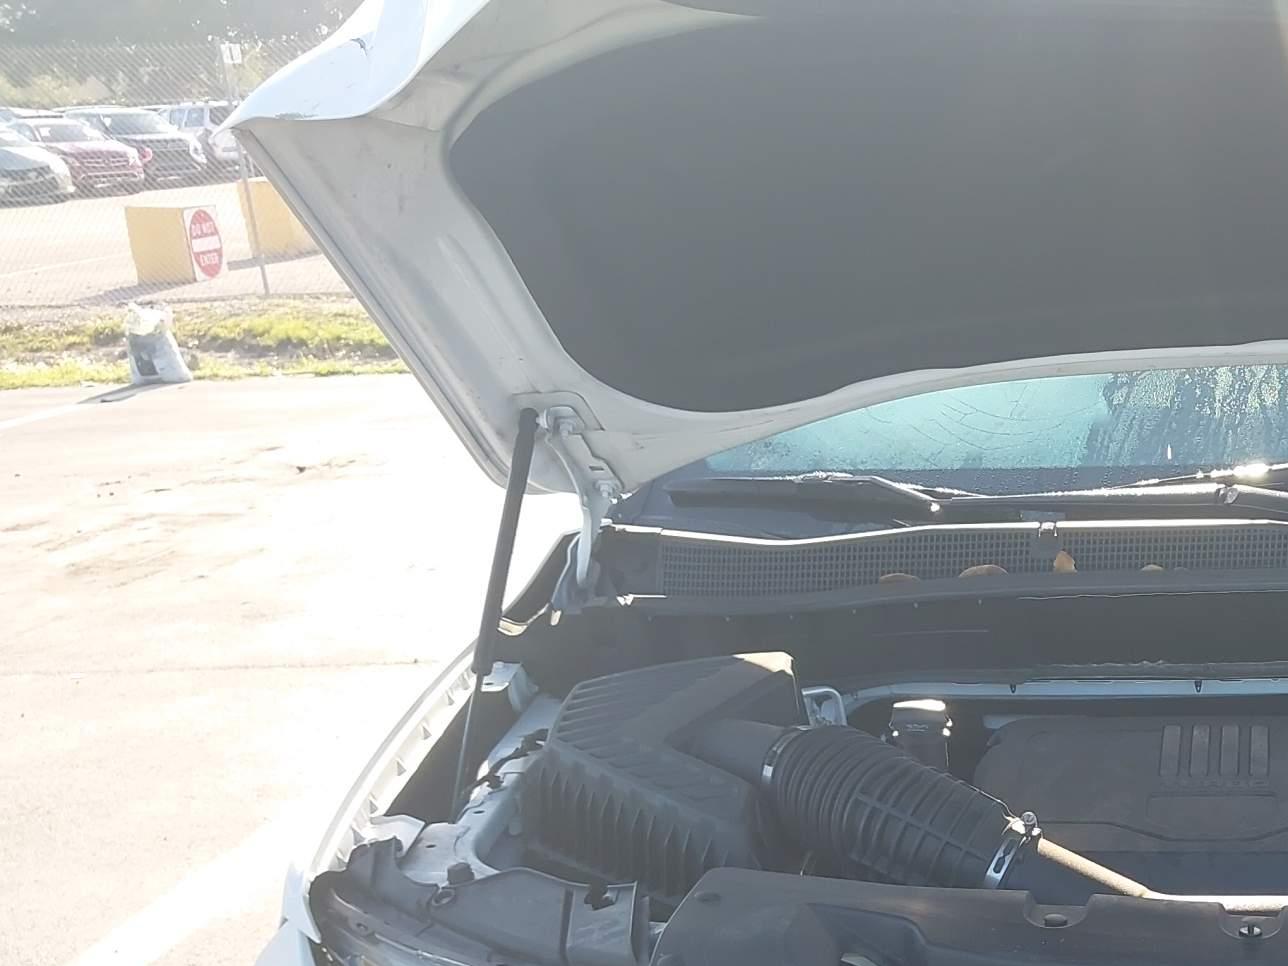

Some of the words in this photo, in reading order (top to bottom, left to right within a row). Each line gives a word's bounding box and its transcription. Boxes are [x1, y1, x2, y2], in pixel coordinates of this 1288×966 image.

[190, 222, 201, 236] DO
[200, 220, 216, 235] NOT
[199, 252, 218, 266] ENTER
